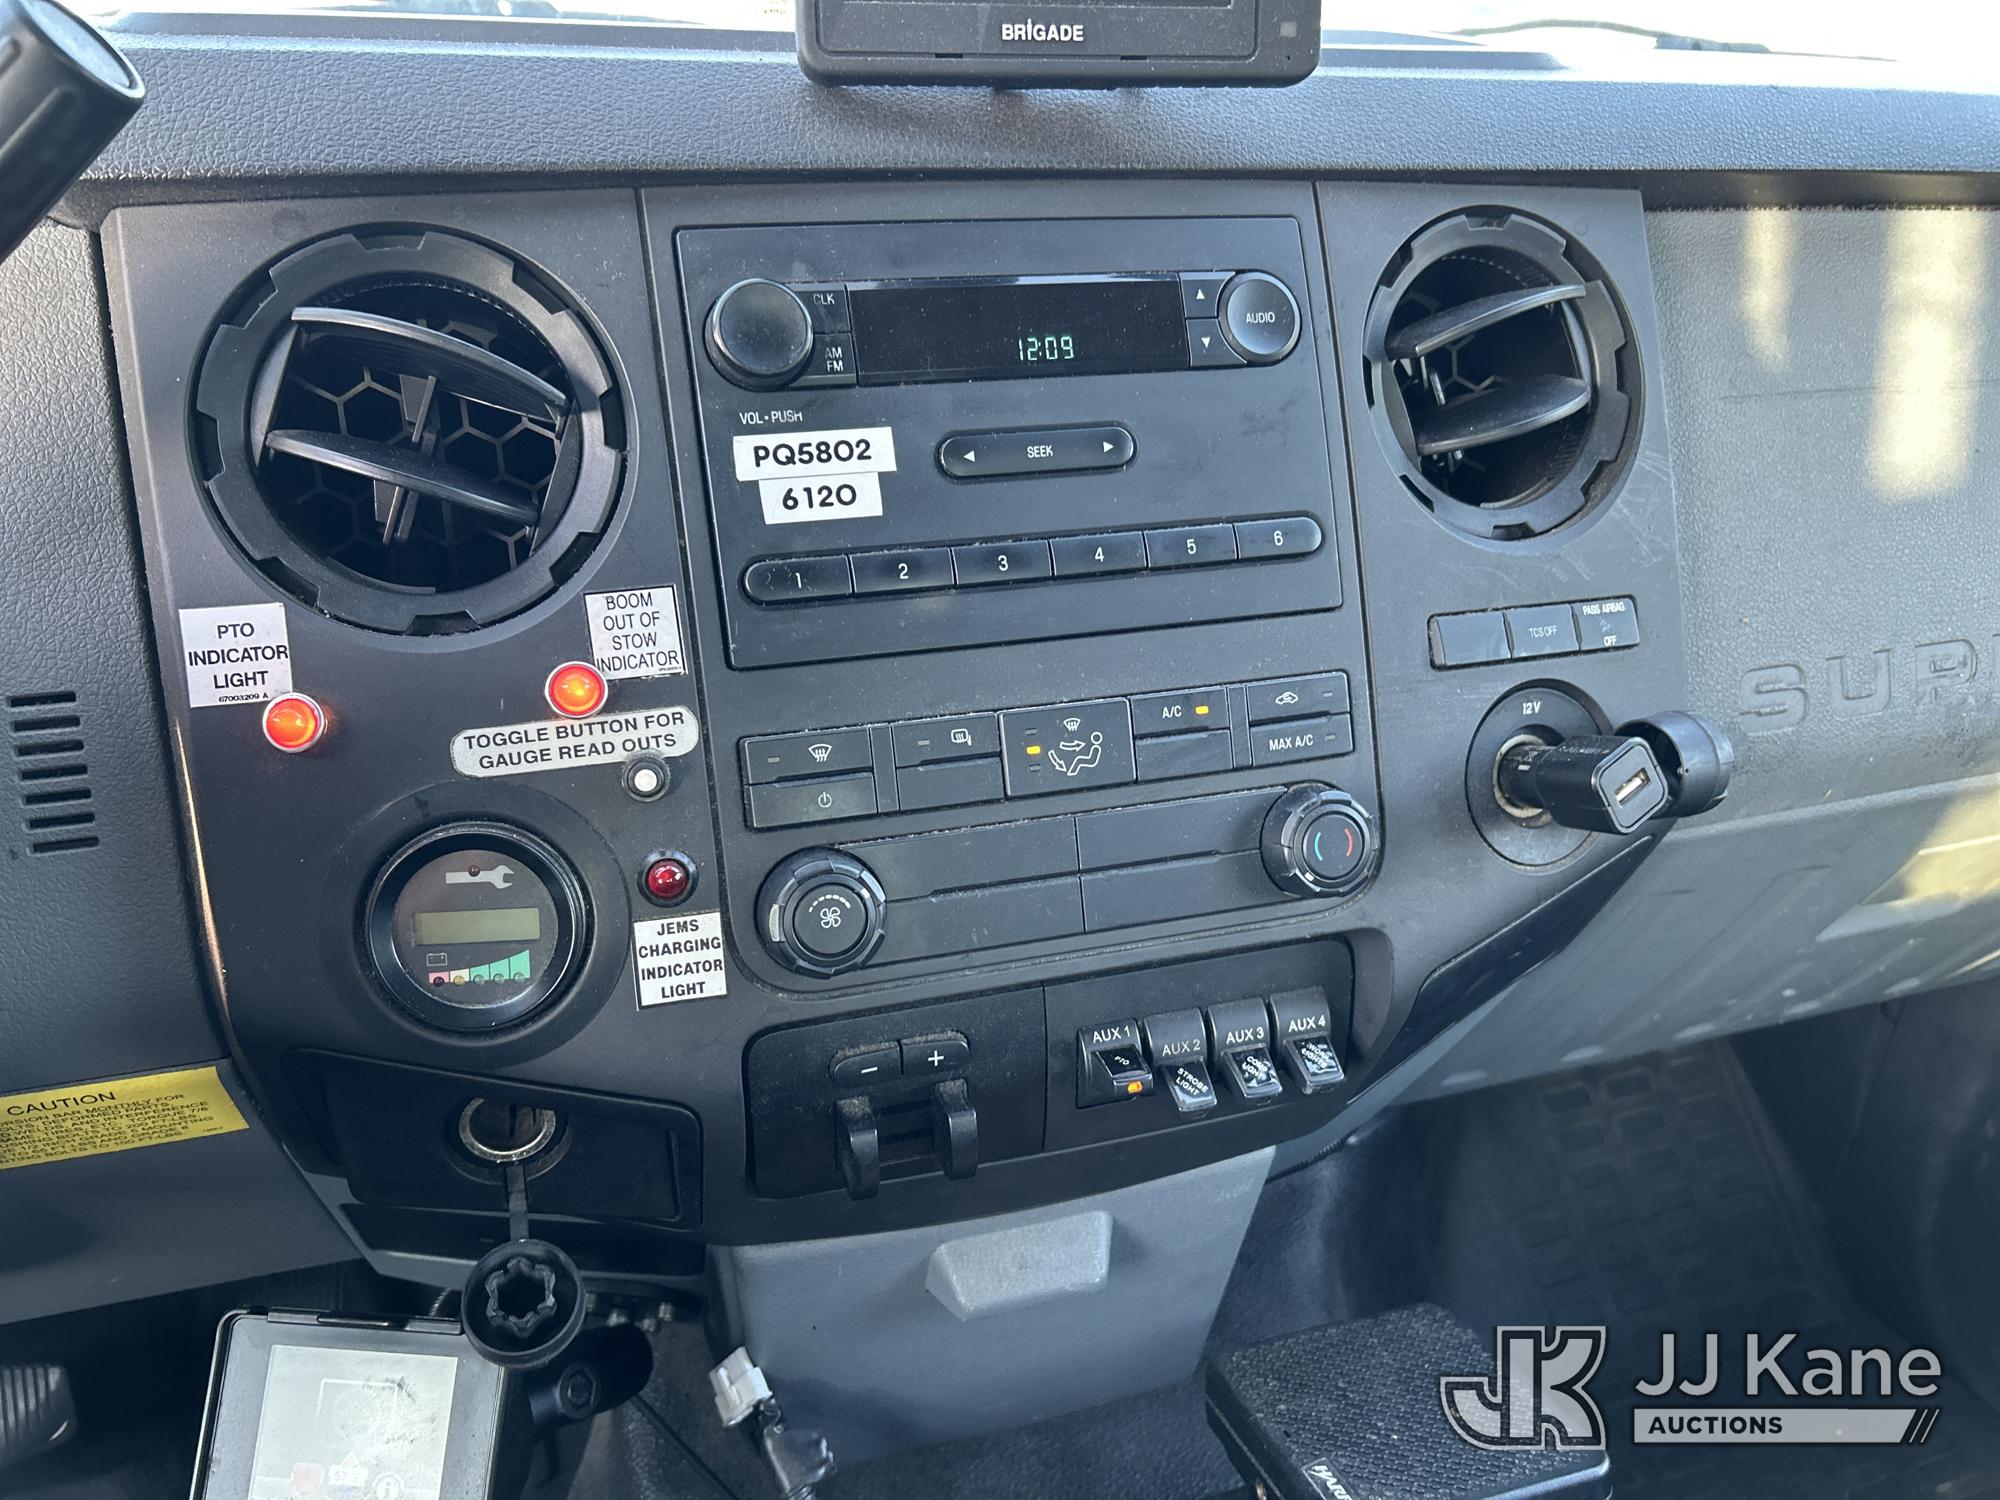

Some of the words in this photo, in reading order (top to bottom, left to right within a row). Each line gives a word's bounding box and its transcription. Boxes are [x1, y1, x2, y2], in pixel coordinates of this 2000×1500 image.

[1001, 18, 1084, 42] BRIGADE
[1246, 311, 1275, 324] AUDIO
[825, 347, 843, 359] AM
[1018, 336, 1075, 362] 12:09
[827, 360, 844, 372] FM
[1027, 445, 1053, 459] SEEK
[782, 484, 857, 511] 6120
[1186, 539, 1197, 555] 5
[1275, 530, 1285, 546] 6
[999, 554, 1009, 572] 3
[1094, 546, 1105, 563] 4
[795, 572, 803, 589] 1
[898, 563, 909, 580] 2
[606, 592, 653, 610] BOOM
[603, 613, 635, 631] OUT
[640, 611, 660, 627] OF
[217, 623, 255, 639] PTO
[1528, 627, 1544, 638] TCS
[1545, 625, 1557, 636] OFF
[612, 632, 657, 650] STOW
[1604, 636, 1617, 646] OFF
[188, 645, 288, 666] INDICATOR
[597, 650, 679, 672] INDICATOR
[213, 671, 269, 689] LIGHT
[1739, 634, 2000, 735] SUP
[1162, 705, 1182, 719] A/C
[464, 728, 549, 750] TOGGLE
[556, 717, 637, 739] BUTTON
[644, 711, 684, 731] FOR
[479, 749, 552, 769] GAUGE
[559, 742, 615, 760] READ
[622, 733, 677, 752] OUTS
[1269, 736, 1292, 751] MAX
[1295, 734, 1313, 748] A/C
[657, 919, 699, 936] JEMS
[638, 936, 721, 958] CHARGING
[641, 959, 723, 981] INDICATOR
[661, 981, 706, 999] LIGHT
[1288, 1016, 1316, 1033] AUX
[1317, 1014, 1326, 1028] 4
[1092, 1027, 1121, 1044] AUX
[1124, 1026, 1131, 1038] 1
[1226, 1028, 1254, 1045] AUX
[1256, 1026, 1265, 1040] 3
[1162, 1040, 1190, 1057] AUX
[1193, 1038, 1201, 1051] 2
[1175, 1076, 1200, 1096] LIGHT
[1177, 1067, 1209, 1093] STROBE
[7, 1092, 116, 1116] CAUTION
[156, 1094, 184, 1102] FOR
